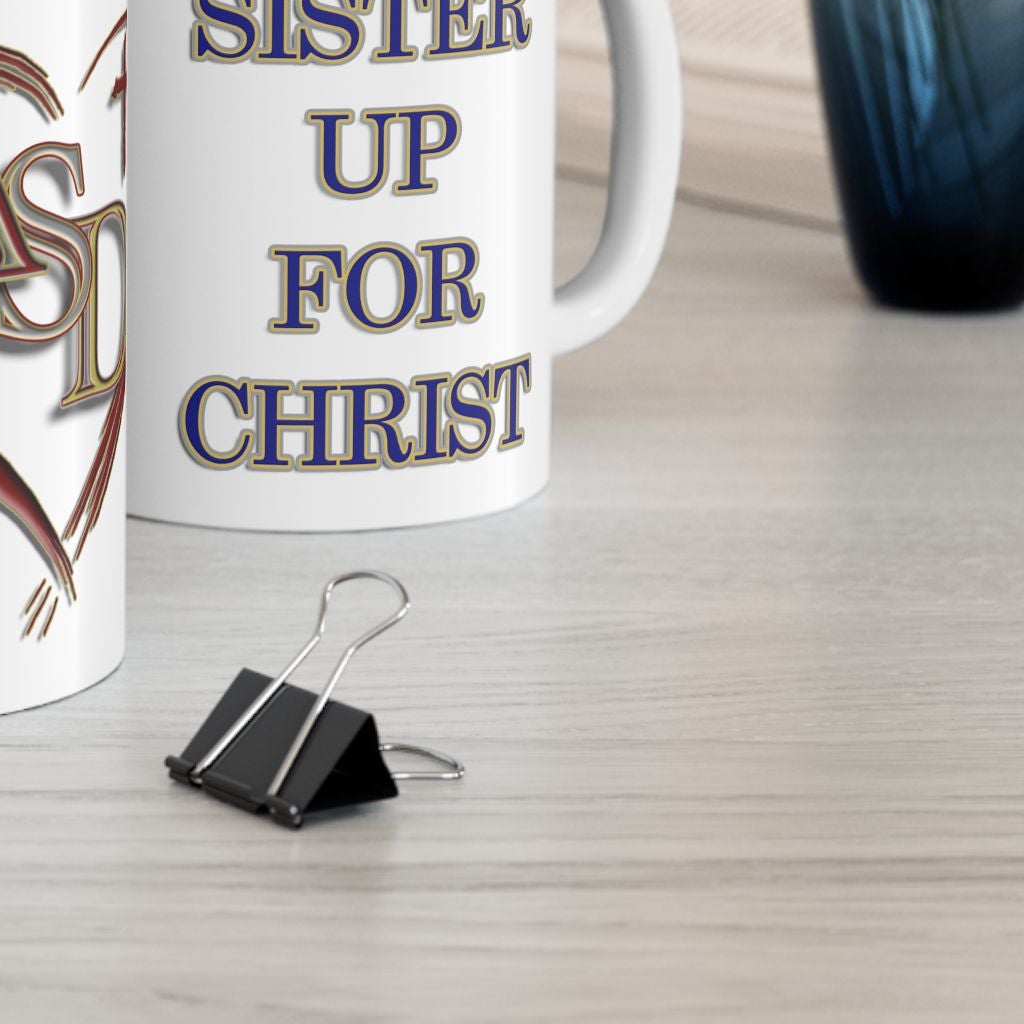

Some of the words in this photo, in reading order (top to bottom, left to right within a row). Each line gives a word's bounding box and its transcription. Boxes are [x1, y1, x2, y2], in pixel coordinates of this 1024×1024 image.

[305, 104, 462, 199] UP
[267, 237, 484, 334] FOR
[178, 353, 532, 471] CHRIST
